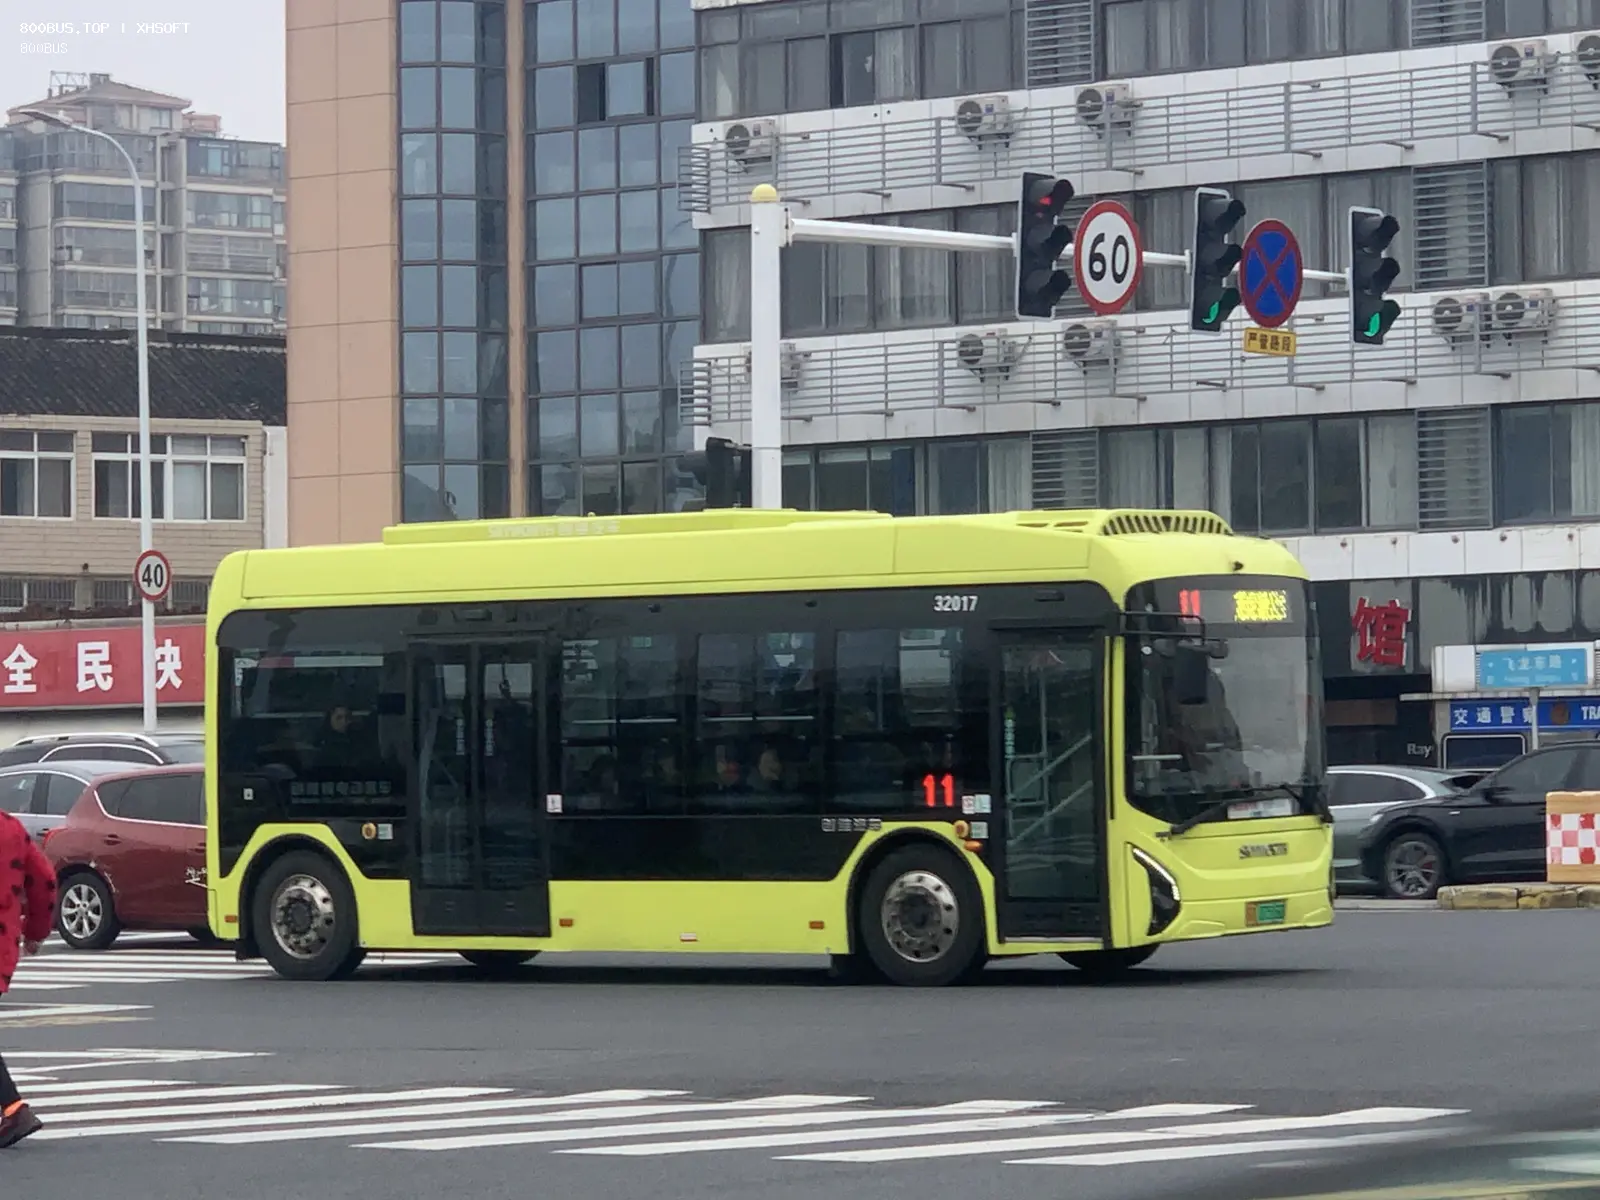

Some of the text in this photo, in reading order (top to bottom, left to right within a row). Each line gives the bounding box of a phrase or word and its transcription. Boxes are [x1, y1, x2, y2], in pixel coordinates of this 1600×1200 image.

[1088, 233, 1129, 284] 60
[142, 563, 164, 588] 40
[933, 594, 979, 612] 32017
[1352, 596, 1412, 667] 馆
[922, 773, 954, 807] 11
